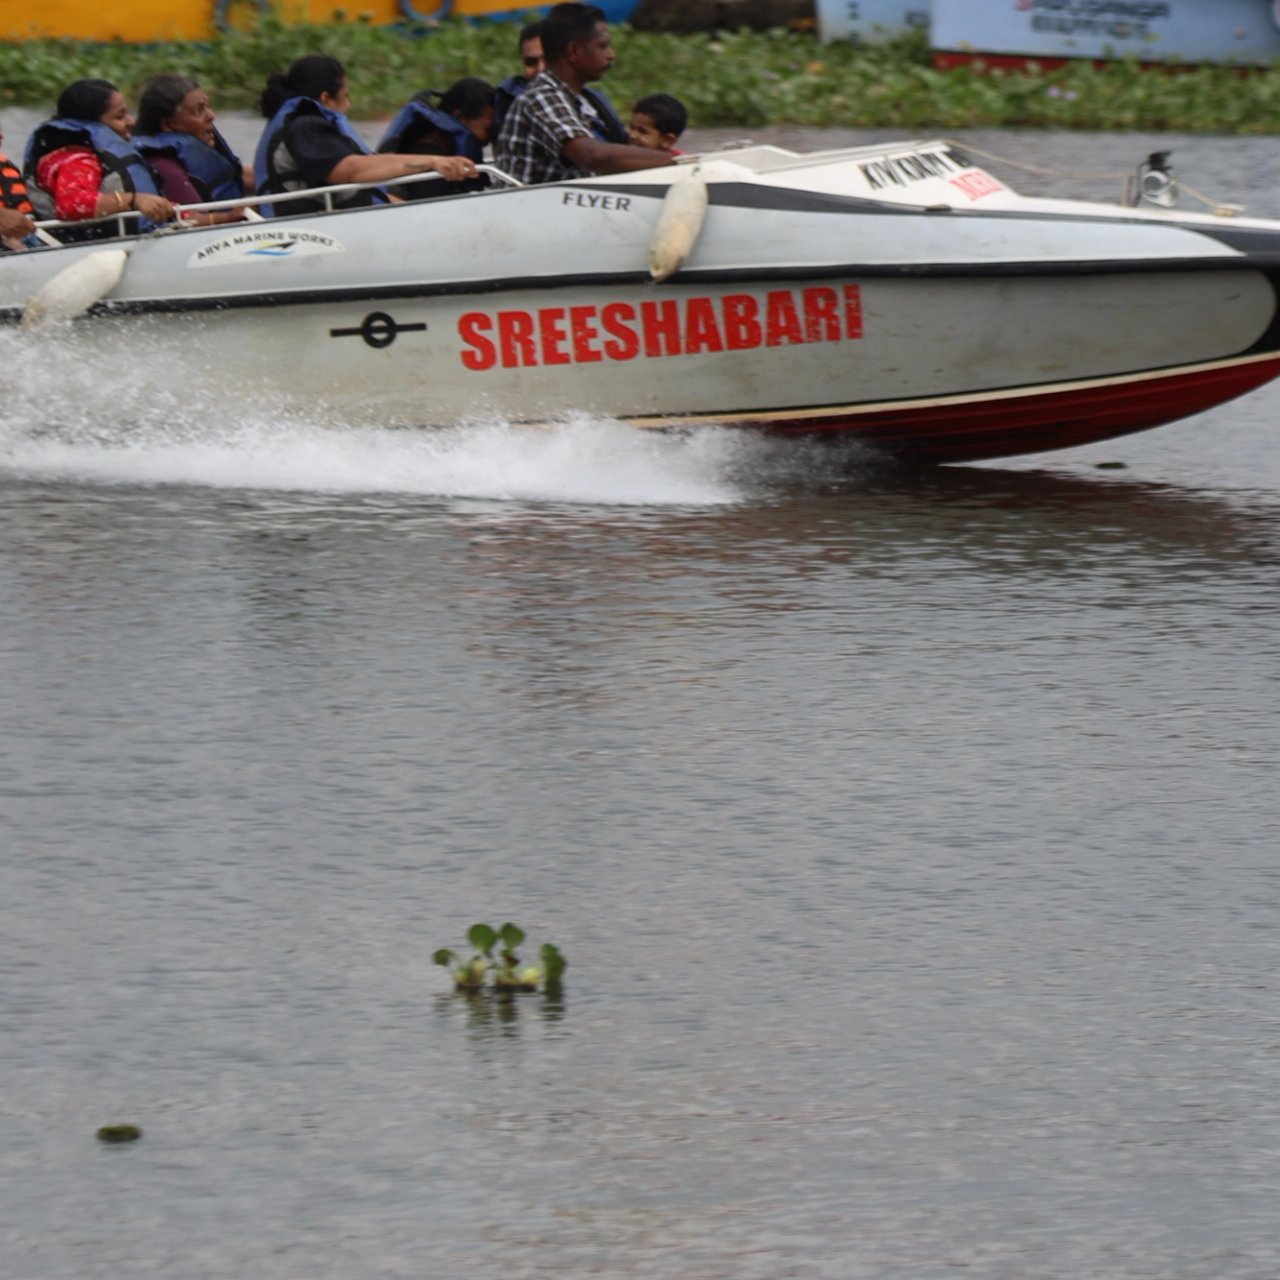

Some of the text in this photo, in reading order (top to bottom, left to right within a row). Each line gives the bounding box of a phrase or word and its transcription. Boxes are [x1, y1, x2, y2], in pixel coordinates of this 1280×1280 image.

[562, 191, 631, 212] FLYER
[197, 231, 334, 259] ARVA MARINE WORKS
[457, 283, 865, 372] SREESHABARI
